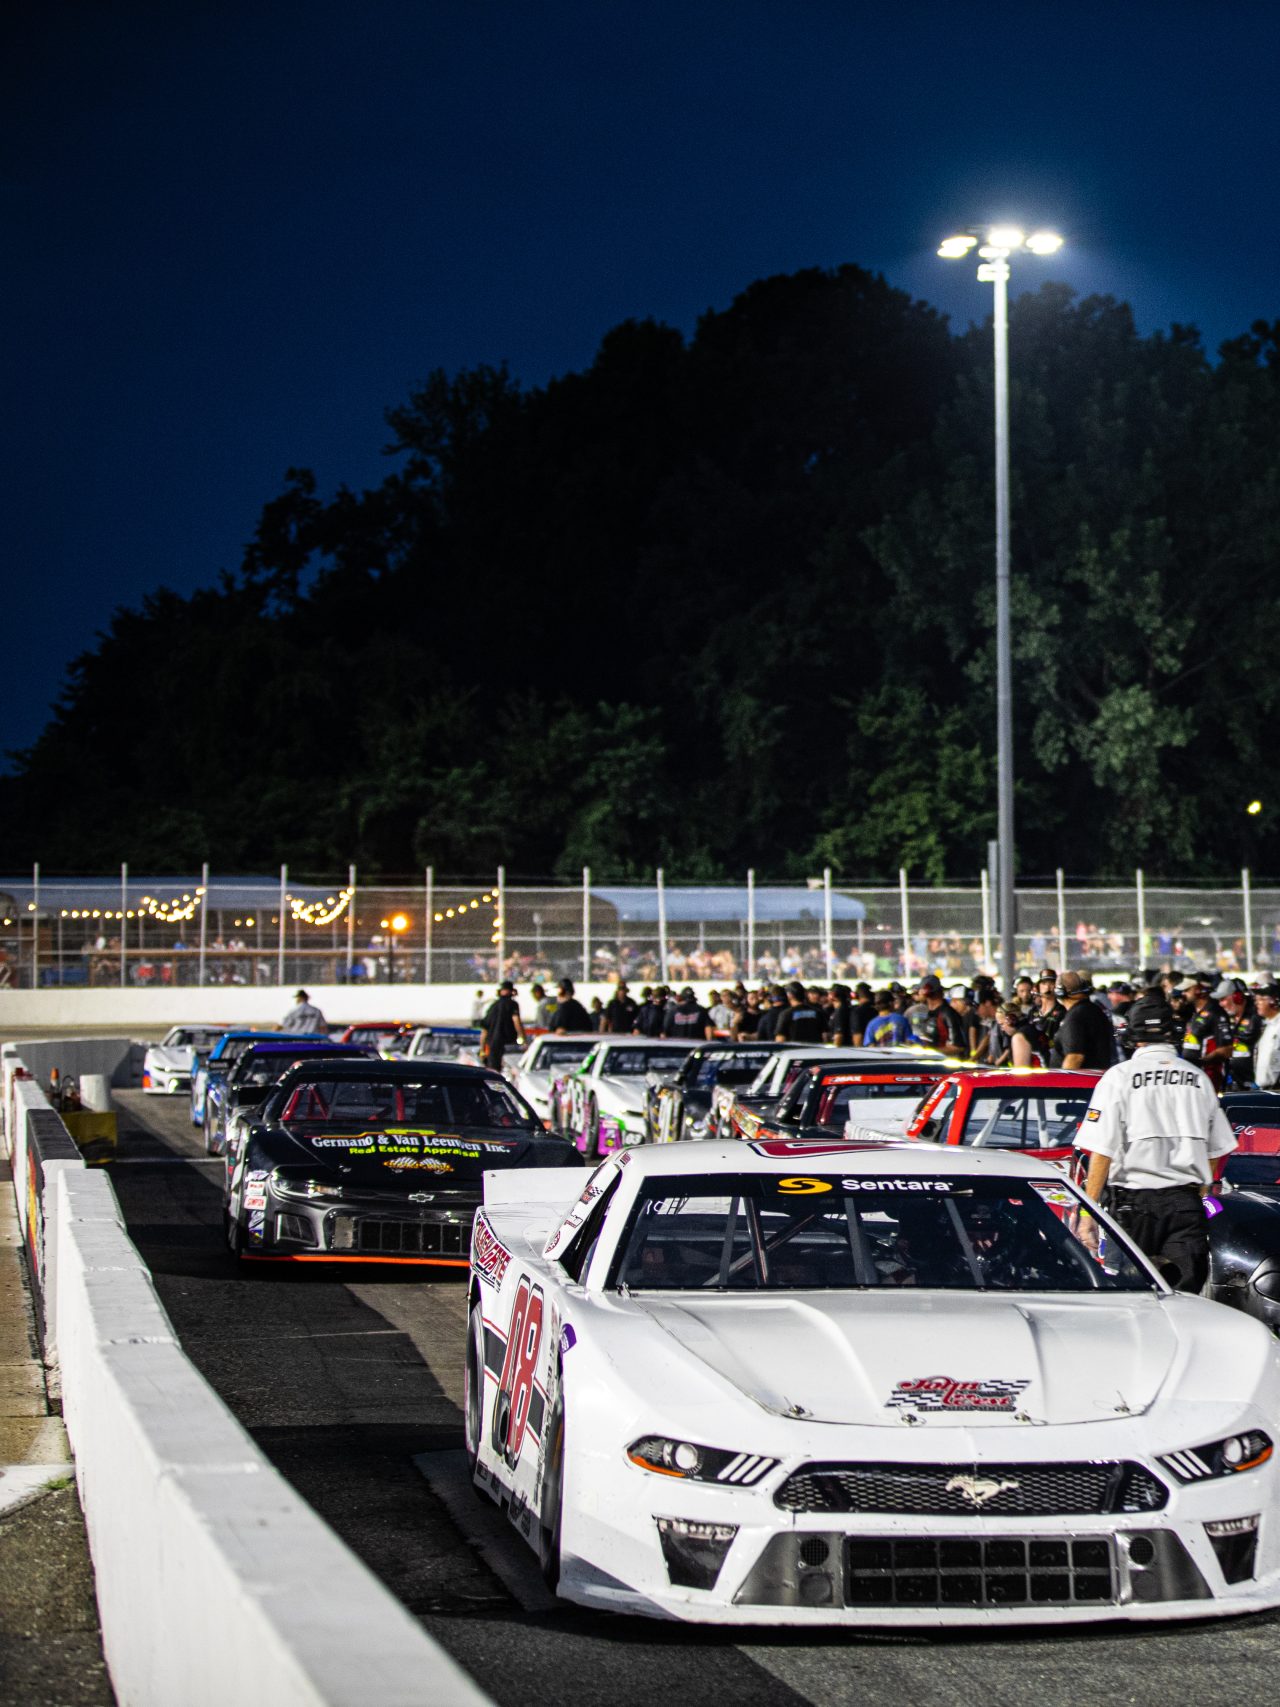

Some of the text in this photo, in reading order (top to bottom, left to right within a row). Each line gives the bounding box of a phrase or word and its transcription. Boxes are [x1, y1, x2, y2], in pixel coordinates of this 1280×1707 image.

[1132, 1069, 1202, 1089] OFFICIAL
[1233, 1125, 1257, 1136] 26
[311, 1136, 374, 1148] Germano
[377, 1134, 392, 1146] &
[393, 1134, 421, 1146] Van
[484, 1142, 511, 1154] Inc.
[349, 1145, 480, 1158] Real Estate Appraisal
[841, 1177, 953, 1192] Sentara
